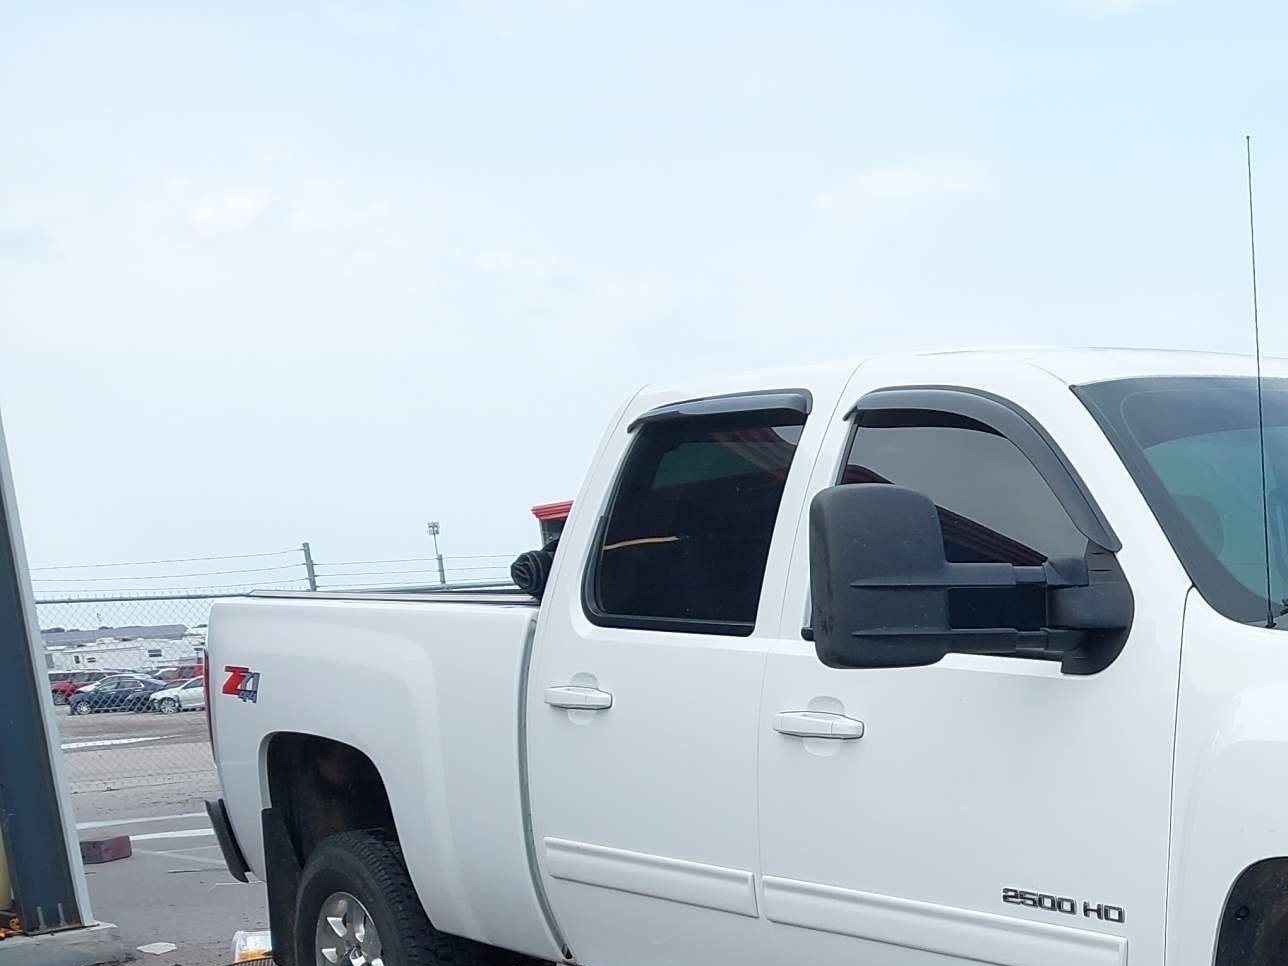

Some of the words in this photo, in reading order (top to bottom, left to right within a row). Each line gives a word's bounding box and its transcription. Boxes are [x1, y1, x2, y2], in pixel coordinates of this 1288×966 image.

[222, 666, 260, 696] Z71
[1002, 887, 1078, 915] 2500
[1083, 901, 1126, 924] HD
